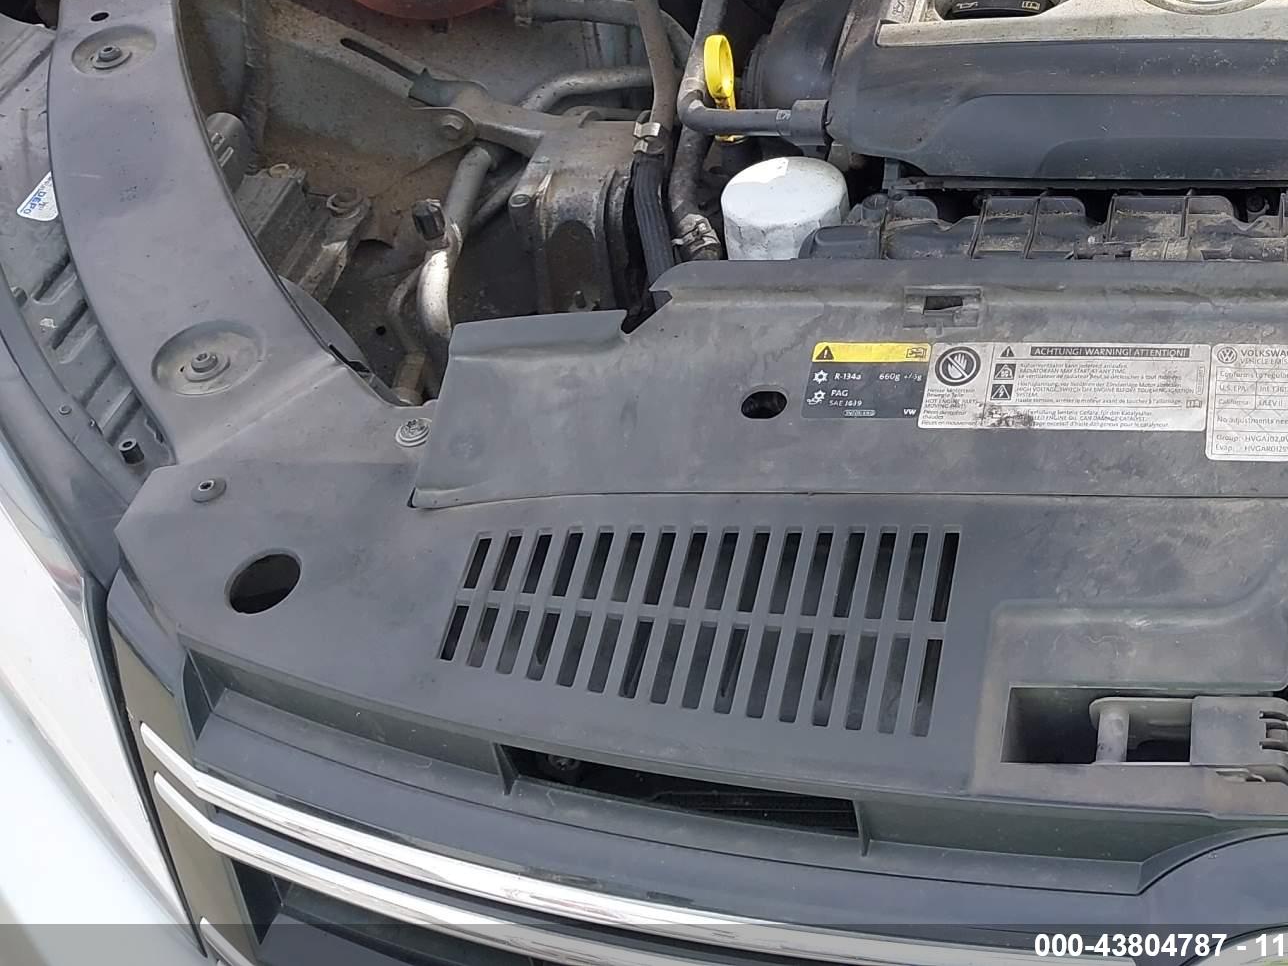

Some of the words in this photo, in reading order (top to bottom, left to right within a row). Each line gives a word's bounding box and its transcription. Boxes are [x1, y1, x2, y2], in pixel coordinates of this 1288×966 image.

[24, 190, 46, 214] DEPO
[1034, 347, 1082, 355] ACHTUNG!
[1085, 348, 1132, 356] WARNING!
[1134, 349, 1187, 357] ATTENTION!
[834, 372, 862, 380] R-134a
[879, 372, 900, 382] 660g
[1229, 417, 1274, 426] adjustments
